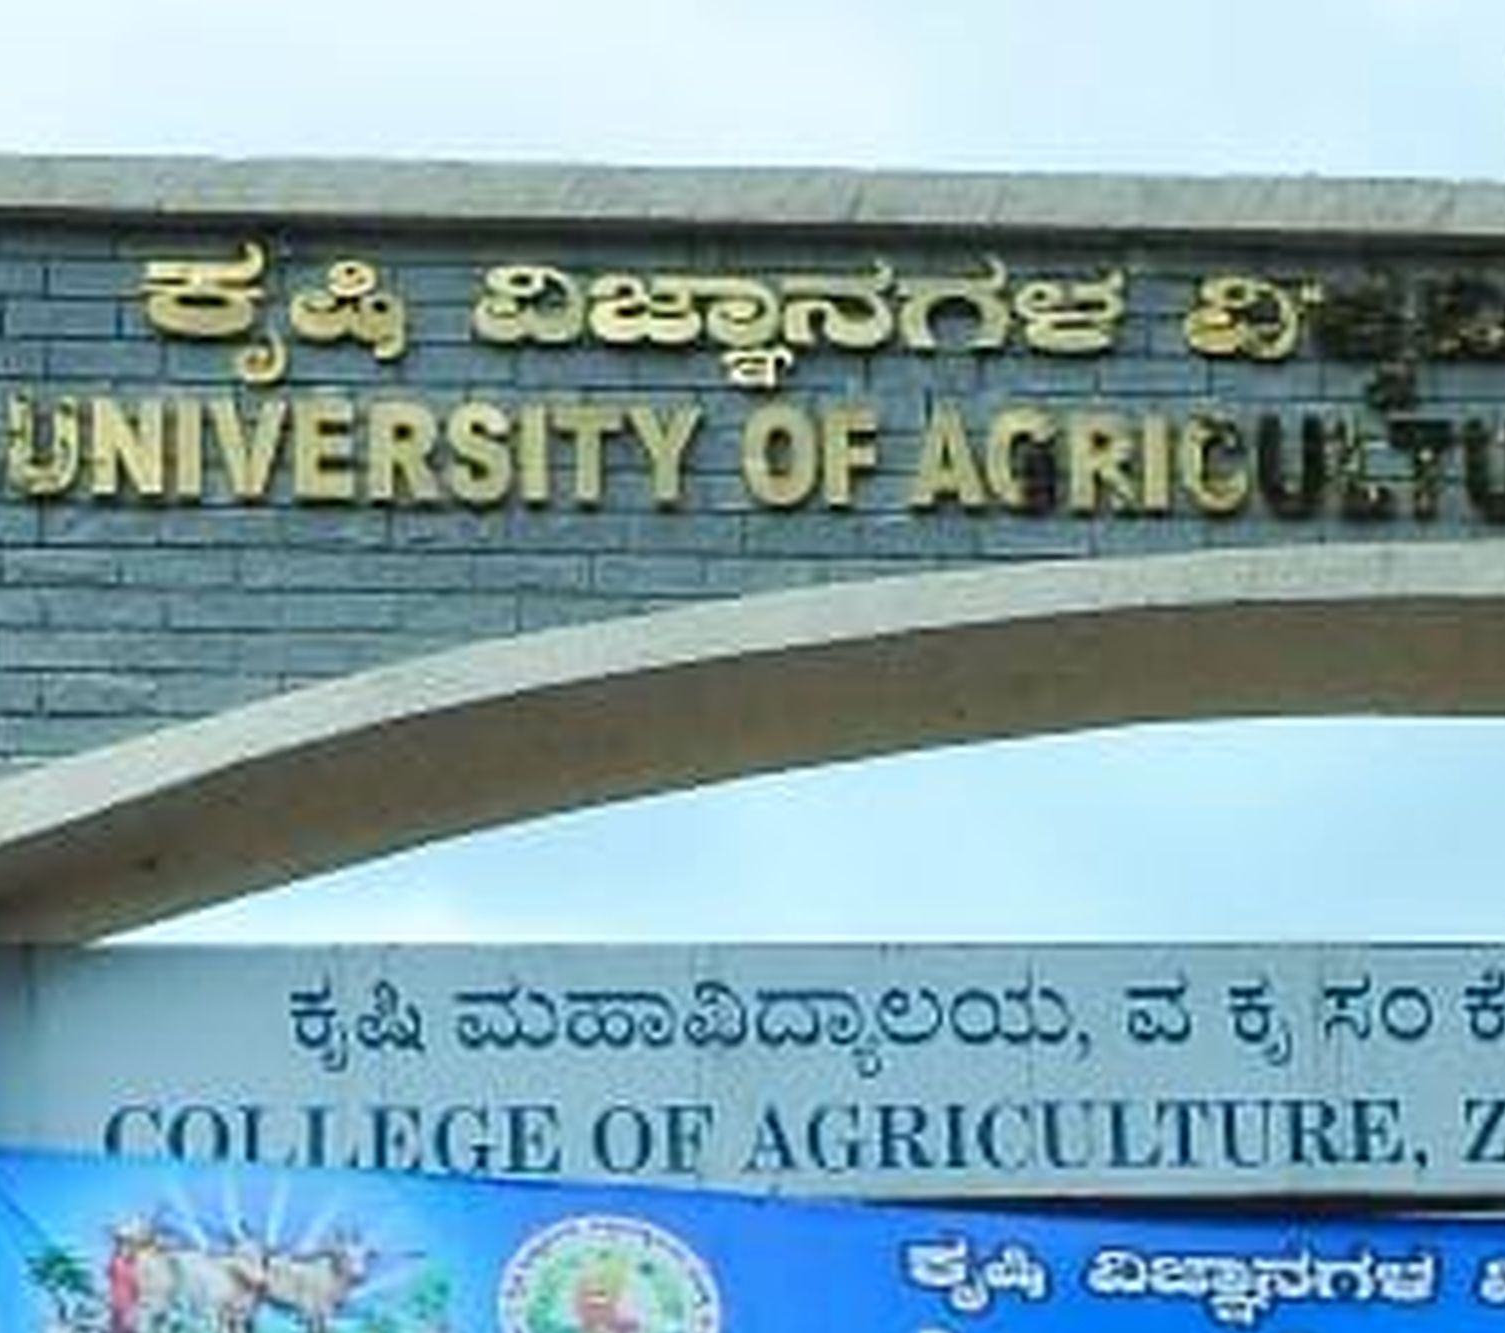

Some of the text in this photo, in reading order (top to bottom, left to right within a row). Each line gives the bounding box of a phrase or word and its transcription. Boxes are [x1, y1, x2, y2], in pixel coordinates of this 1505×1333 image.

[140, 243, 408, 384] ಕೃಷಿ
[474, 252, 1124, 390] ವಿಜ್ಞಾನಗಳ
[7, 396, 701, 507] UNIVERSITY
[740, 402, 880, 509] OF
[290, 976, 426, 1072] ಕೃಷಿ
[455, 975, 1091, 1078] ಮಹಾವಿದ್ಯಾಲಯ,
[103, 1103, 562, 1173] COLLEGE
[592, 1103, 716, 1174] OF
[741, 1098, 1429, 1174] AGRICULTURE,
[906, 1236, 1046, 1311] ಕೃಷಿ
[1087, 1245, 1435, 1326] ವಿಜ್ಞಾನಗಳ
